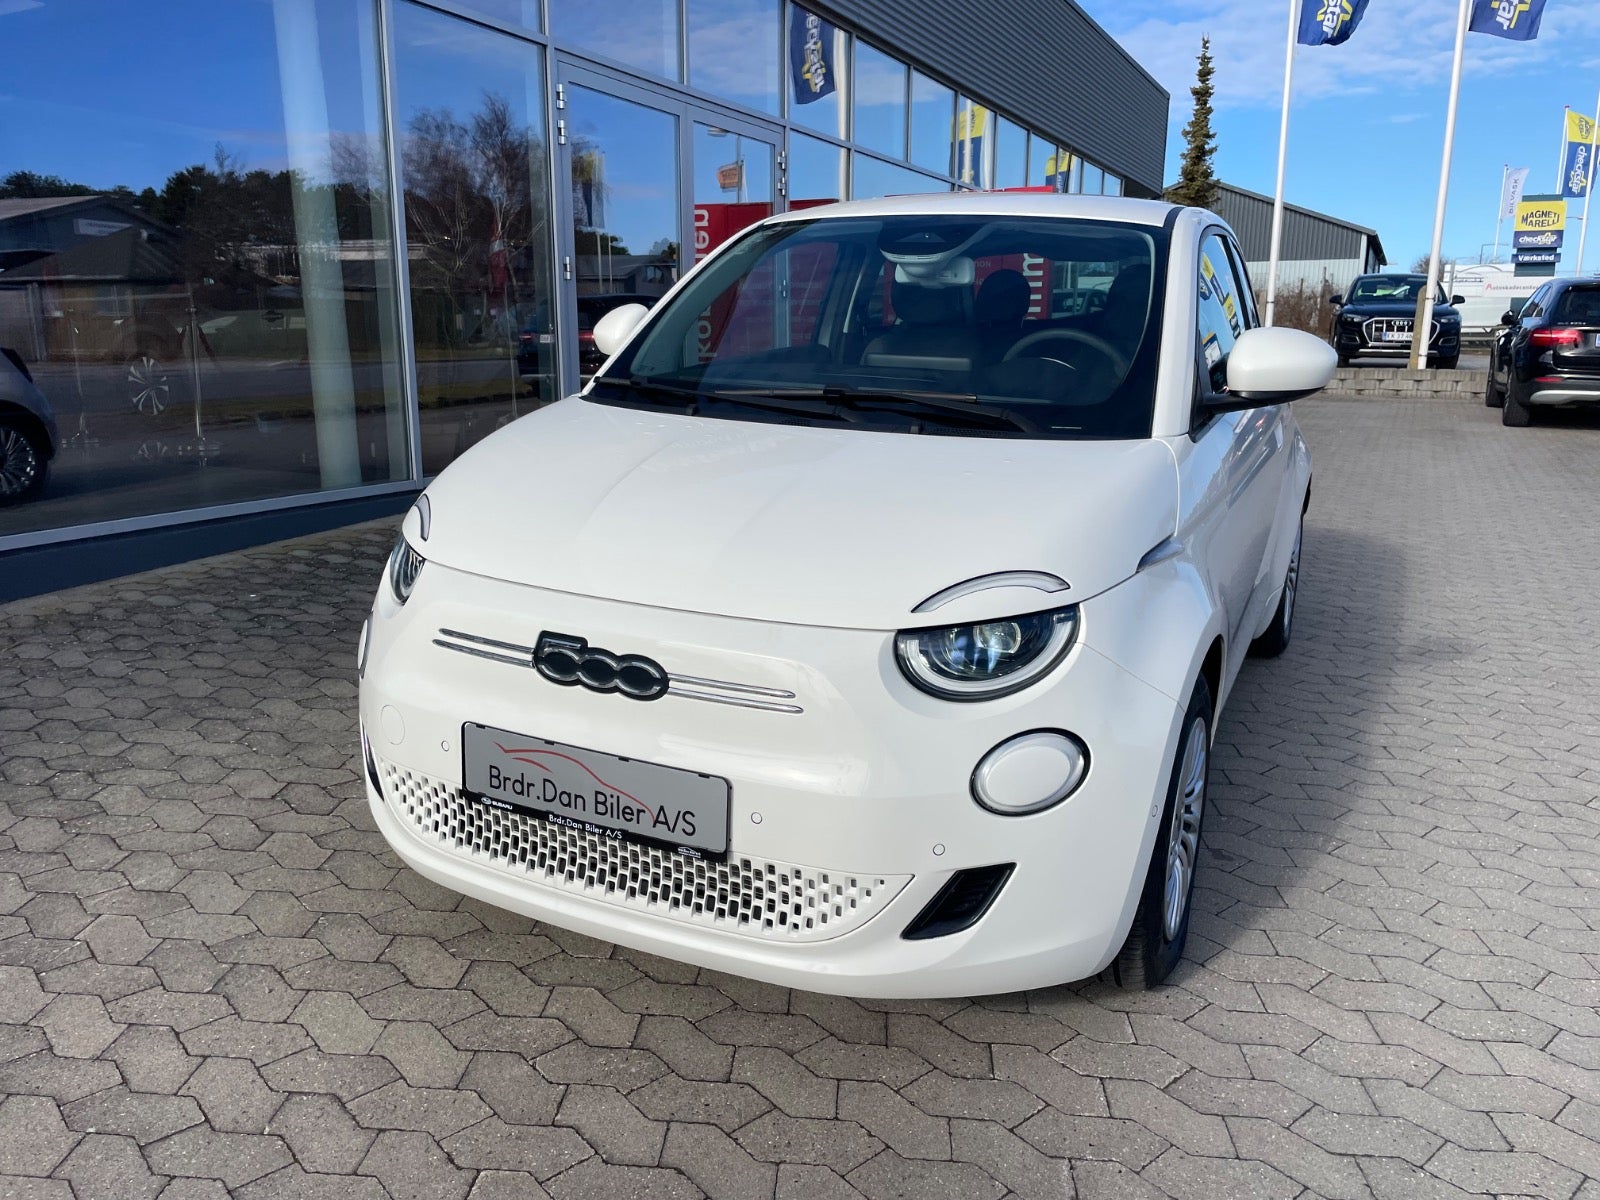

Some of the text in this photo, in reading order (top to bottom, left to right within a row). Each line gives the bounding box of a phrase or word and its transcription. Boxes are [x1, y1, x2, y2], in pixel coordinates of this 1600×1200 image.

[1571, 145, 1587, 194] checkstar
[1521, 210, 1560, 223] MAGNETI
[1519, 233, 1557, 244] checkstar
[1518, 254, 1555, 262] Værksted
[533, 630, 669, 701] 500
[492, 800, 513, 811] SUBARU
[594, 790, 646, 825] Biler
[652, 805, 697, 837] A/S
[585, 824, 605, 834] Biler
[606, 829, 622, 839] A/S
